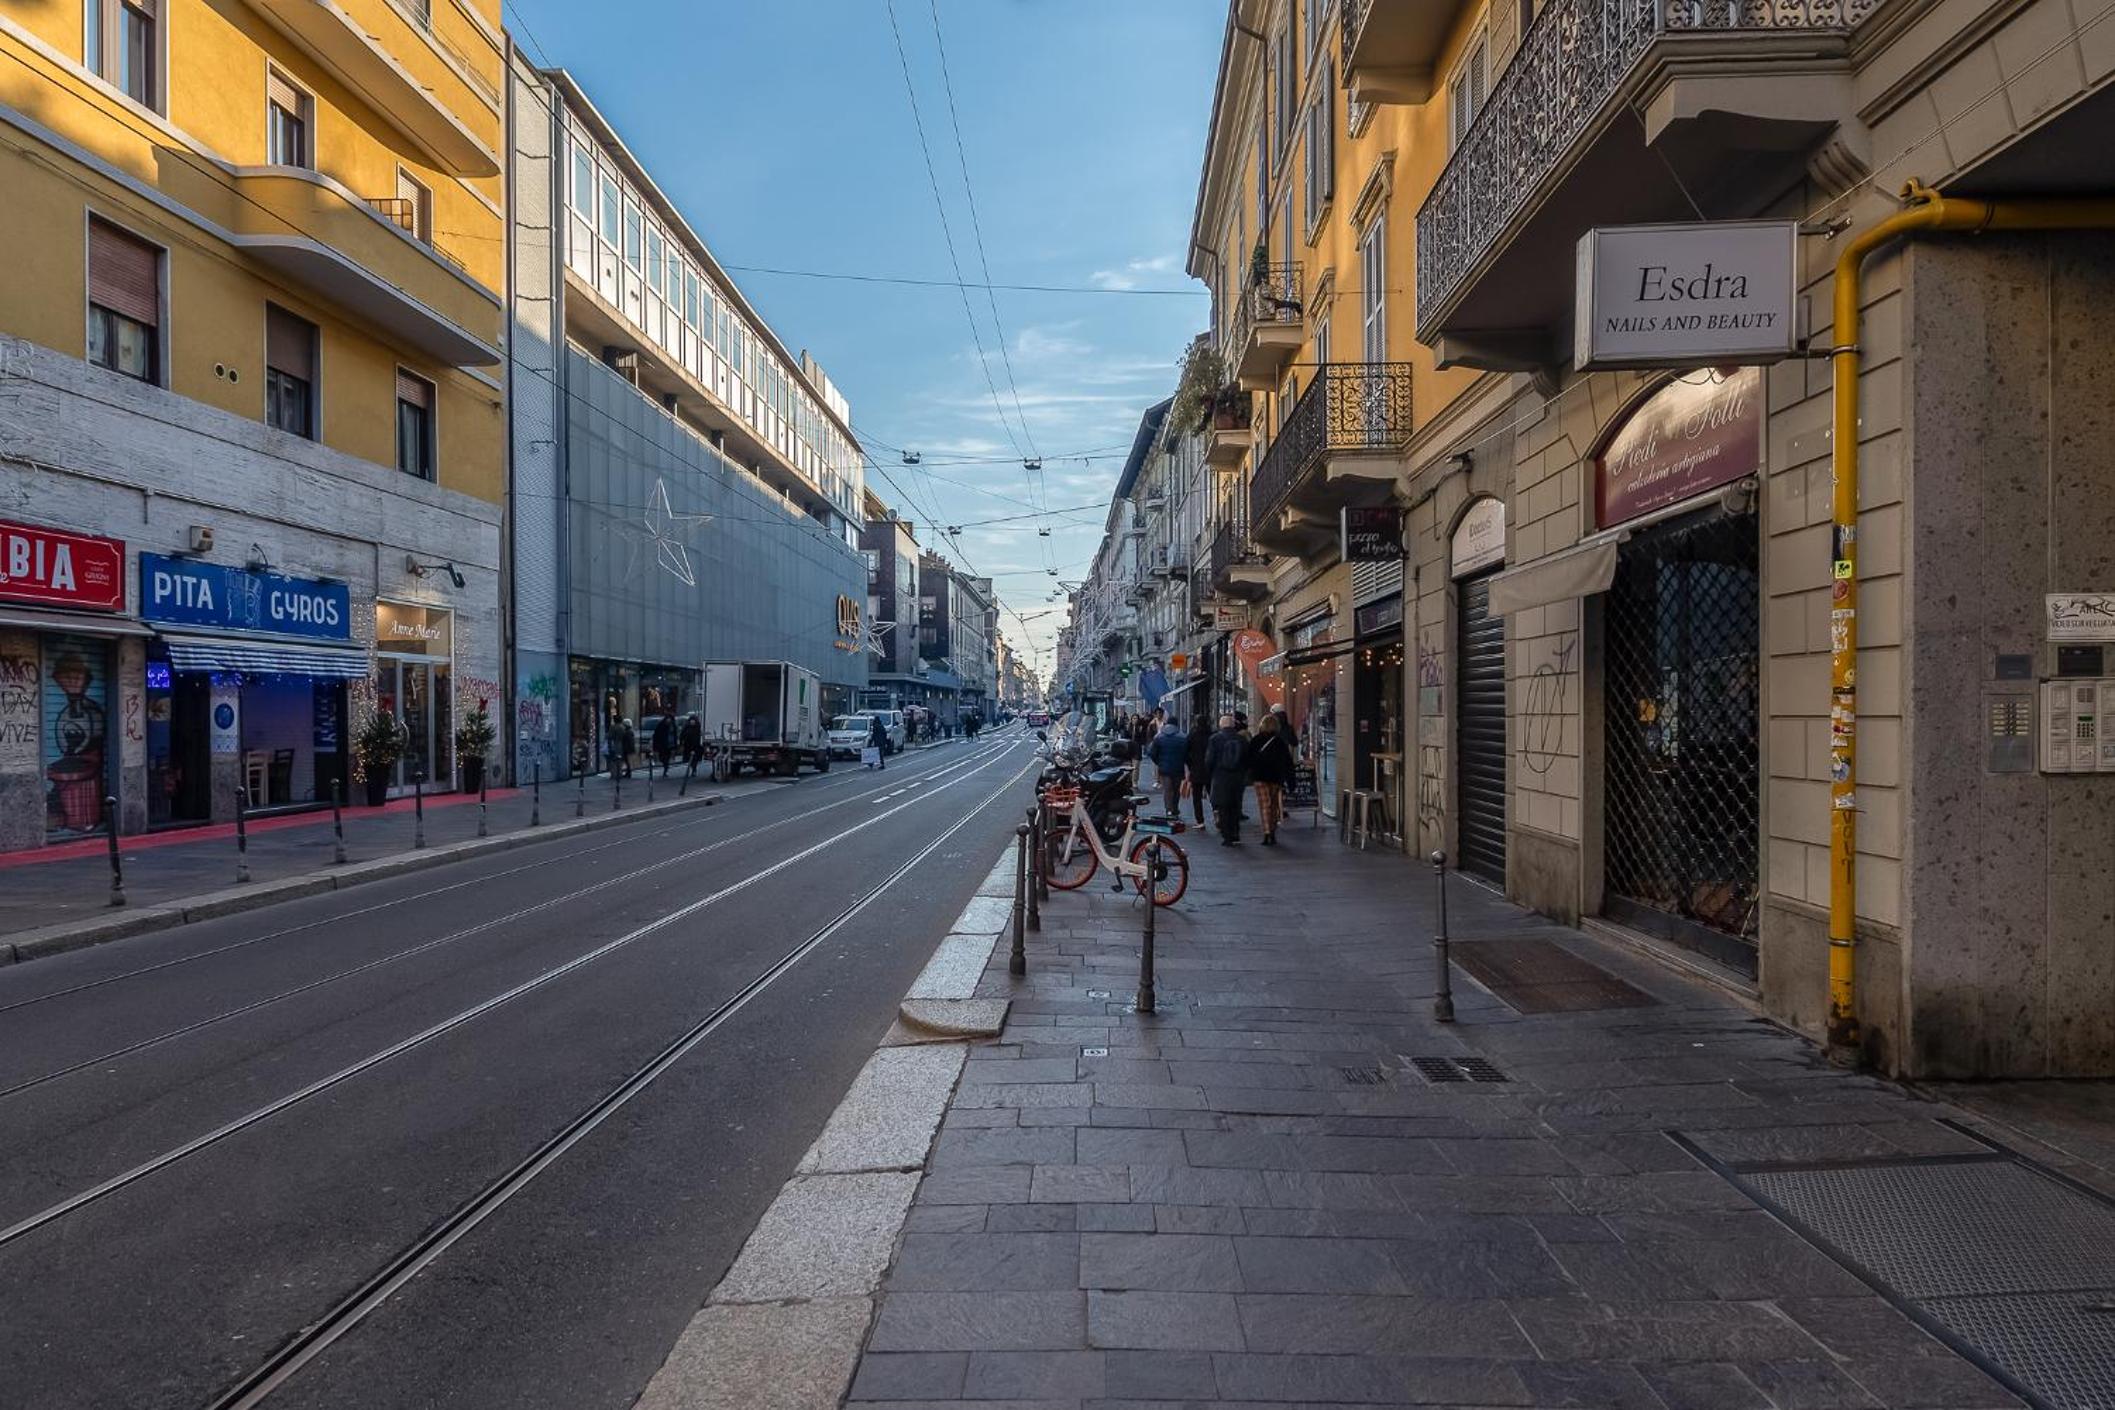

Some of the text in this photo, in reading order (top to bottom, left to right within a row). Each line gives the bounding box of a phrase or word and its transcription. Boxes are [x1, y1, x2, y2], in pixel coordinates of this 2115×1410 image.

[1634, 263, 1749, 301] Esdra
[1606, 312, 1777, 332] NAILS AND BEAUTY
[1685, 380, 1747, 440] Folli
[0, 533, 77, 592] BIA
[154, 571, 214, 610] PITA
[271, 590, 340, 626] GYROS
